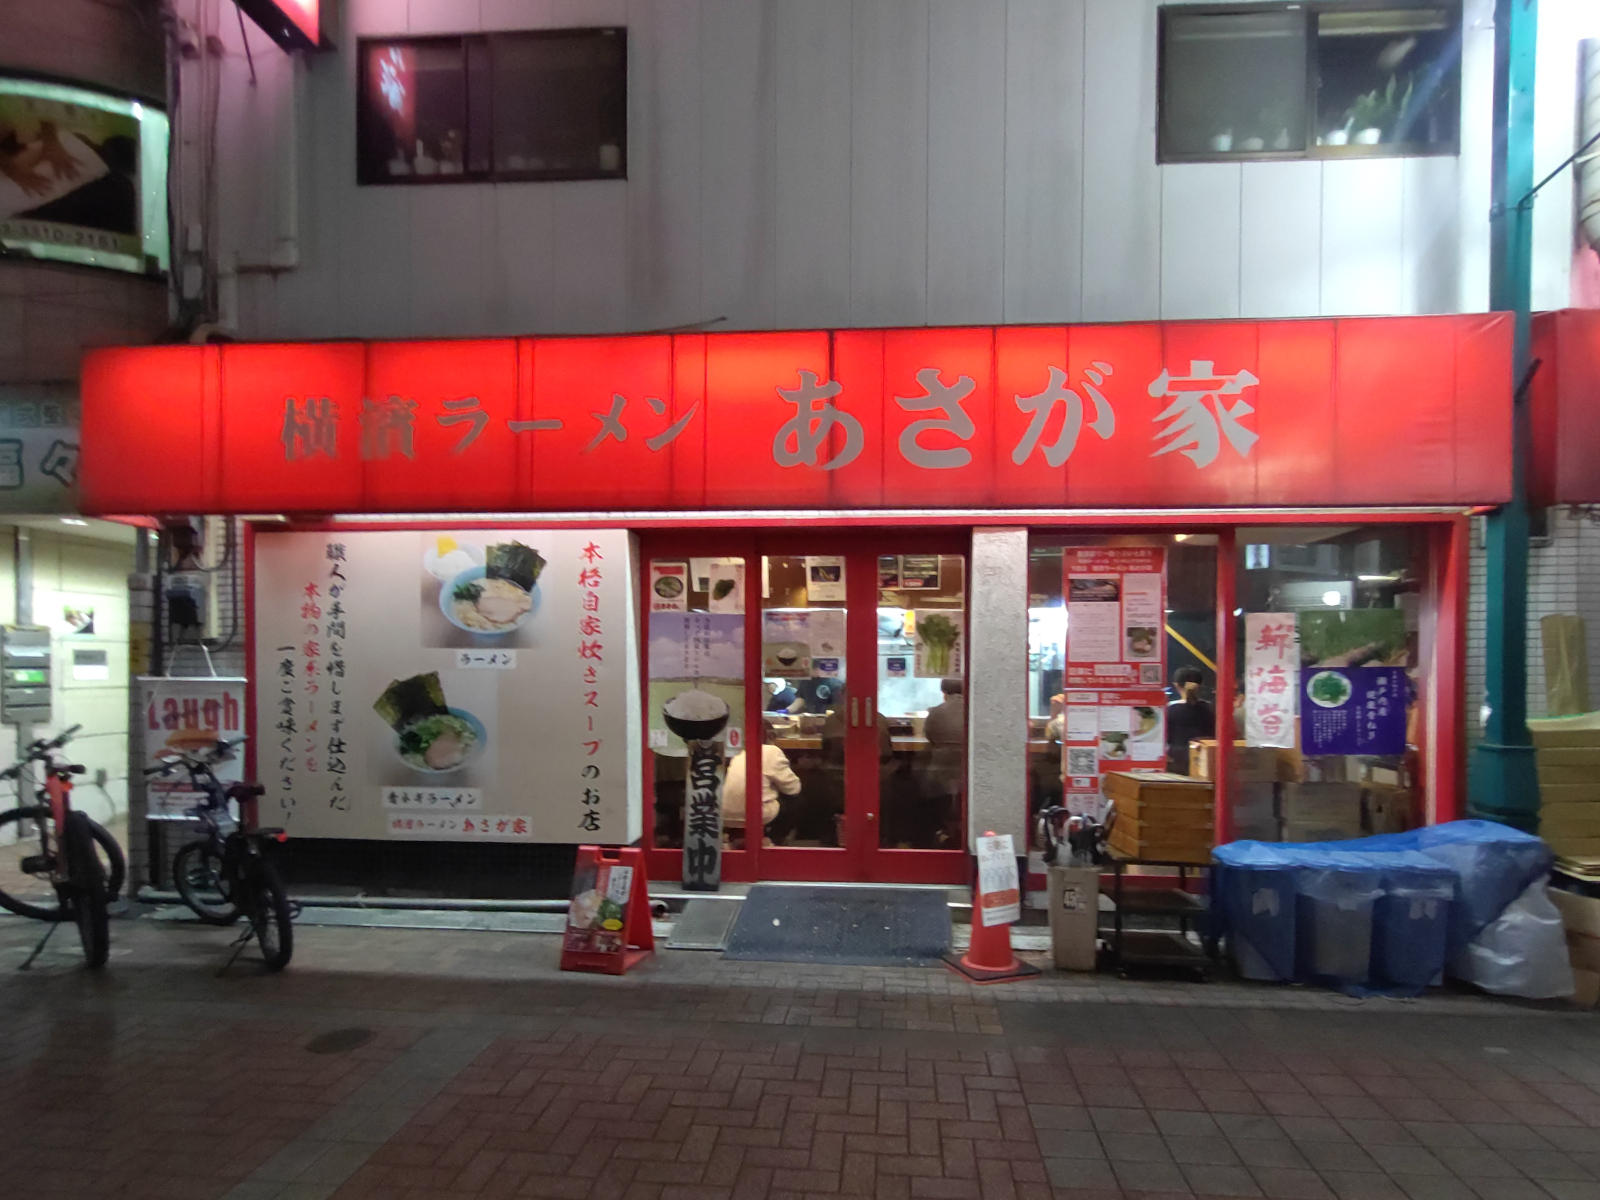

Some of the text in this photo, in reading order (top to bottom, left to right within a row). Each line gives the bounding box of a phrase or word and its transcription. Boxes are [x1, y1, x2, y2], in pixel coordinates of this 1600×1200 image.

[281, 361, 1260, 469] 横濱ラーメン あさが家
[147, 690, 239, 731] Laugh
[300, 581, 322, 773] 本物の家系ラーメンを
[460, 653, 515, 666] ラーメン
[577, 541, 604, 831] 本格自家炊きスープのお店
[1255, 624, 1292, 736] 新海苔
[462, 817, 528, 834] あさが家
[688, 751, 723, 885] 営業中
